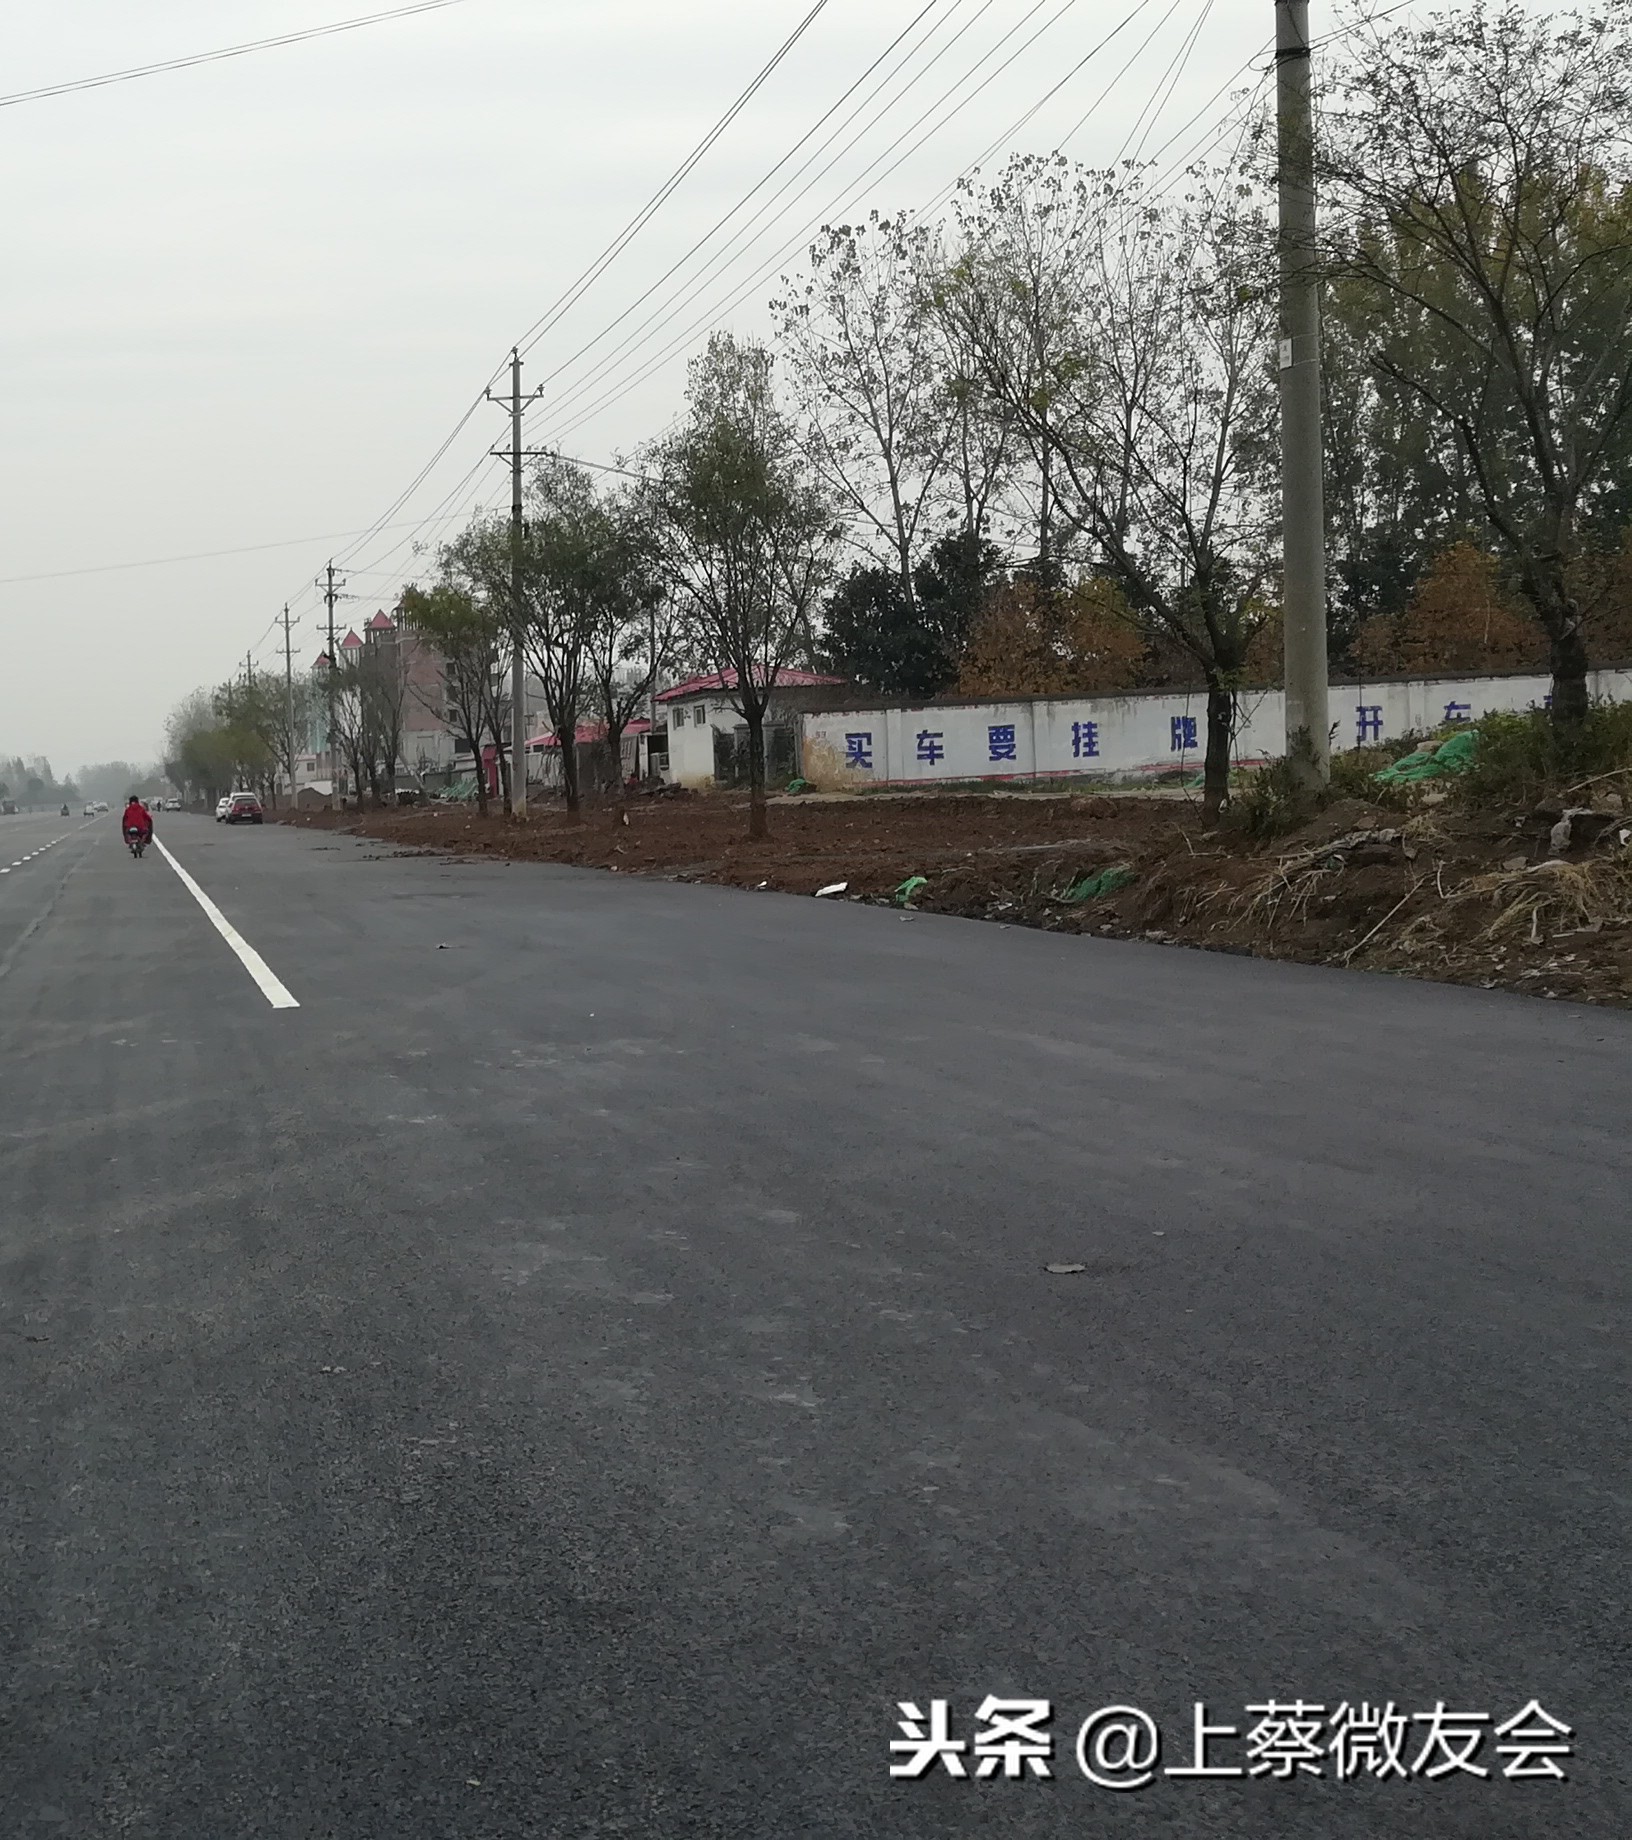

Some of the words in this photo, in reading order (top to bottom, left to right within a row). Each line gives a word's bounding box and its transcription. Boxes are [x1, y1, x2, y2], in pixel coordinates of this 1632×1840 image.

[845, 716, 1198, 769] 买车要挂牌
